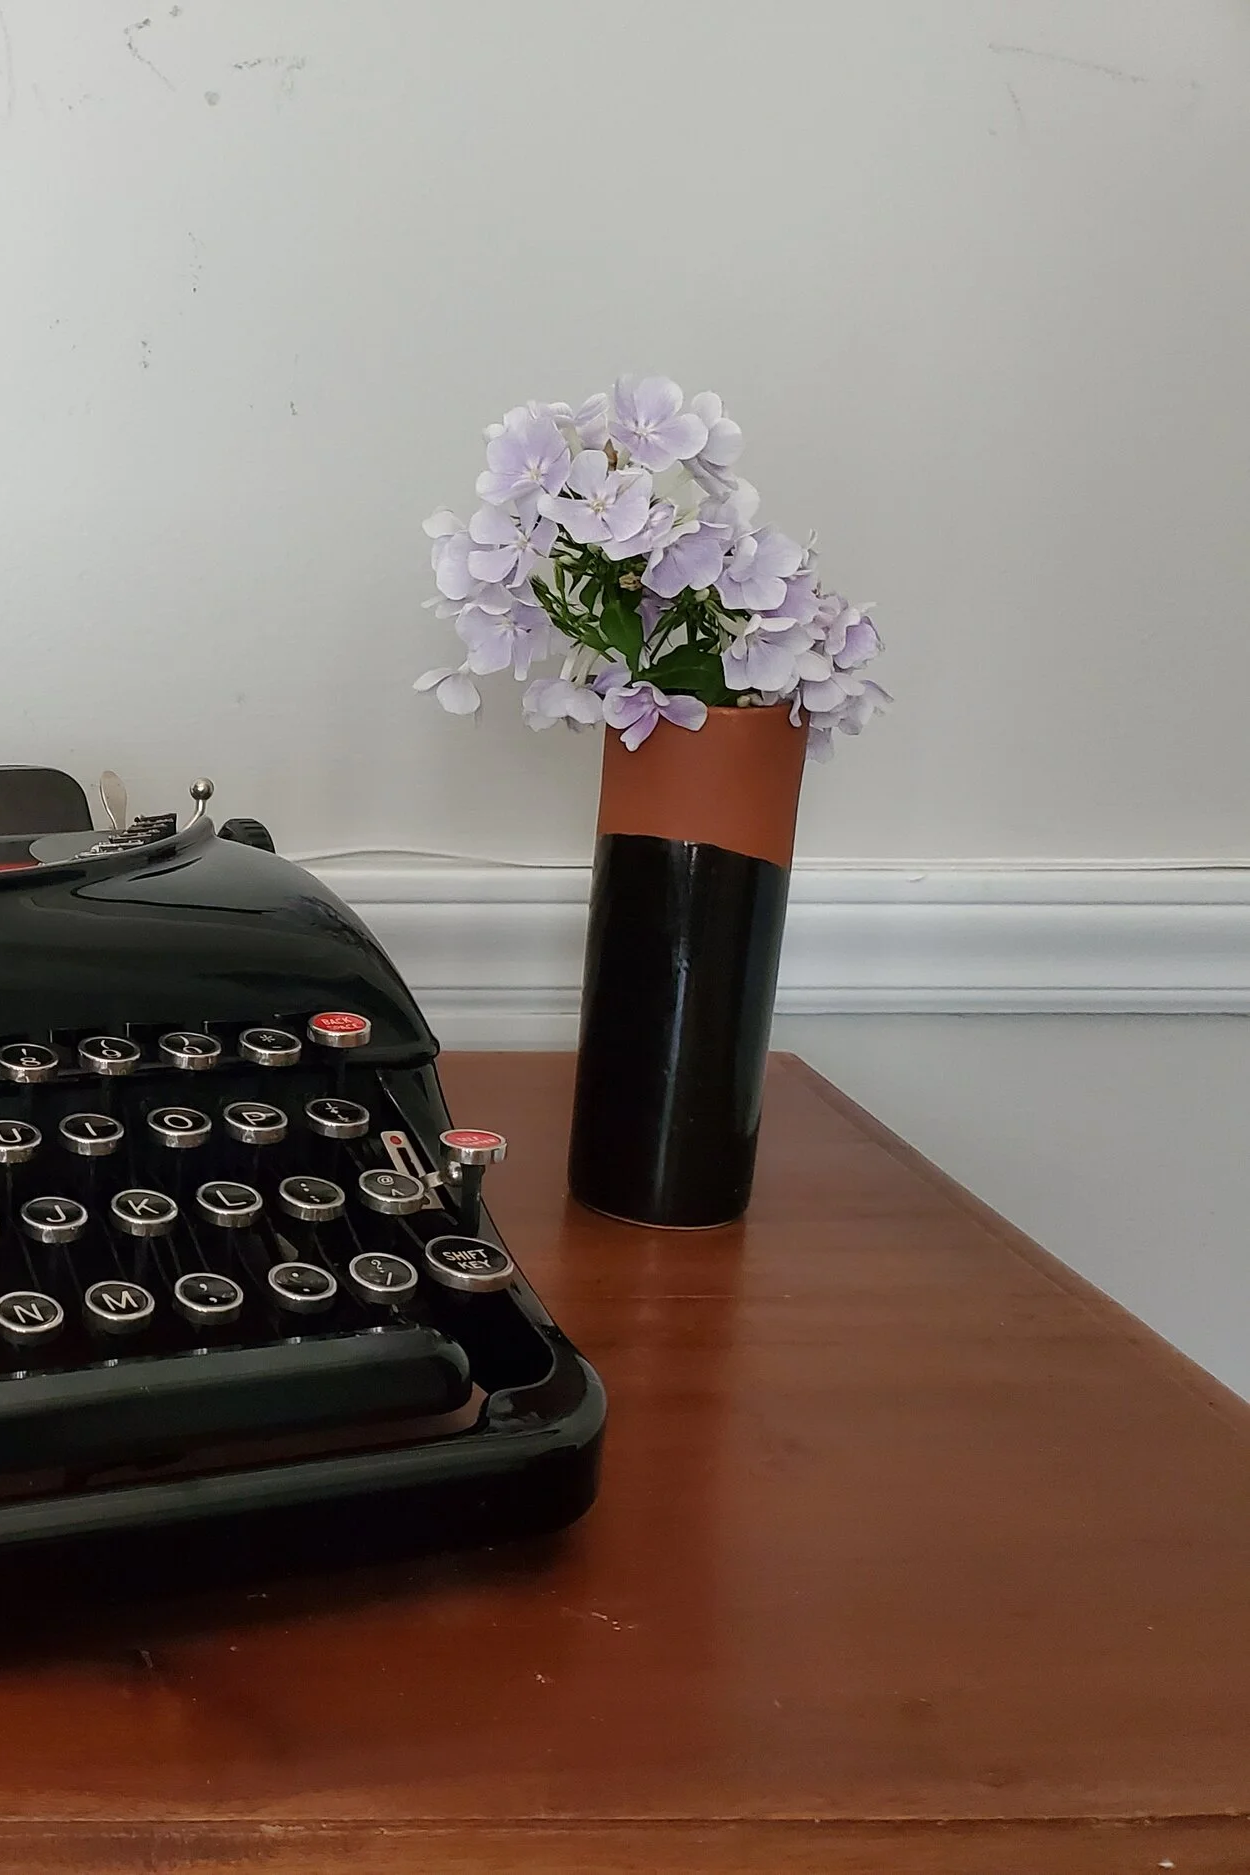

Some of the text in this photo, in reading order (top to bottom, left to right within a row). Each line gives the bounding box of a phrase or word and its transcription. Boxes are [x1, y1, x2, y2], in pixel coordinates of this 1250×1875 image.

[321, 1017, 353, 1025] BACK
[20, 1057, 41, 1067] 8
[101, 1049, 122, 1059] 9
[163, 1114, 193, 1130] O
[241, 1111, 264, 1127] P
[84, 1123, 97, 1137] I
[215, 1190, 247, 1207] L
[45, 1205, 67, 1223] J
[127, 1199, 159, 1216] K
[443, 1249, 488, 1262] SHIFT
[457, 1259, 492, 1270] KEY
[101, 1290, 139, 1311] M
[13, 1304, 44, 1324] N
